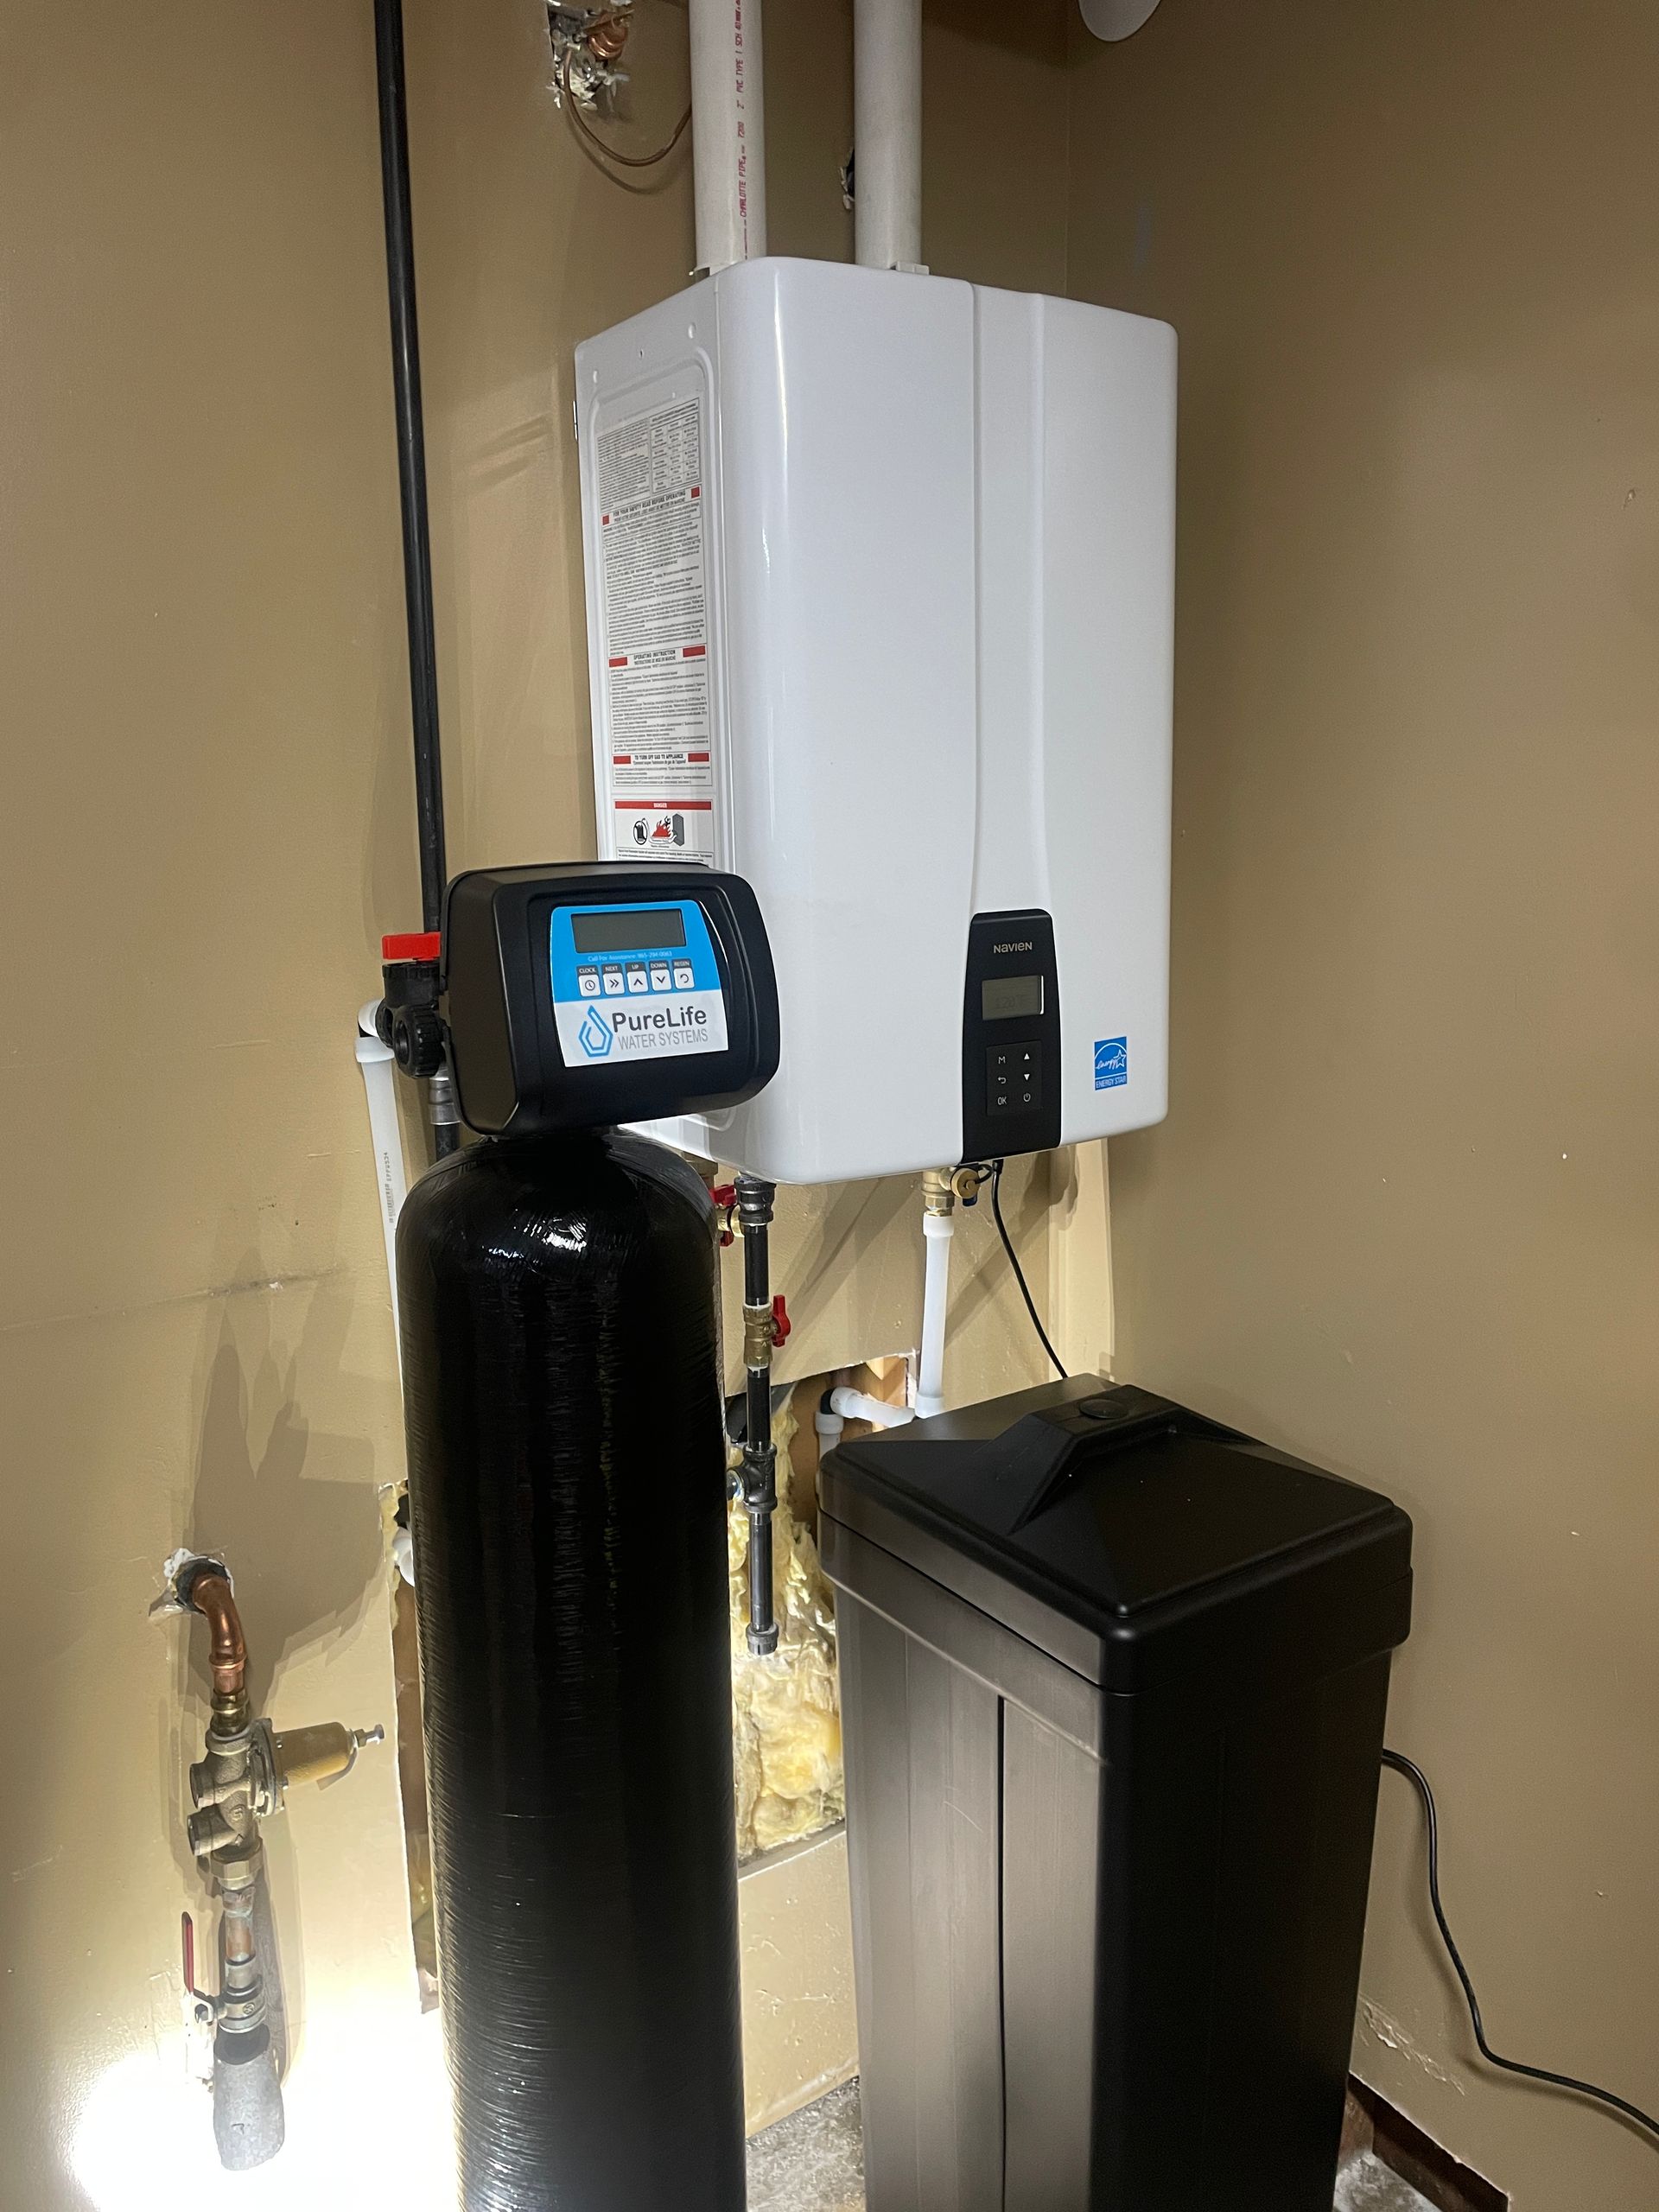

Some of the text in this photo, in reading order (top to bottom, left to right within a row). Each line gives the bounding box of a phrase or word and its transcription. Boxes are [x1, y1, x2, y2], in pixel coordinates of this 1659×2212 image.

[612, 1006, 707, 1033] PureLife
[618, 1028, 709, 1051] WATER SYSTEMS
[1096, 1076, 1127, 1089] ENERGY STAR
[997, 1096, 1007, 1105] OK
